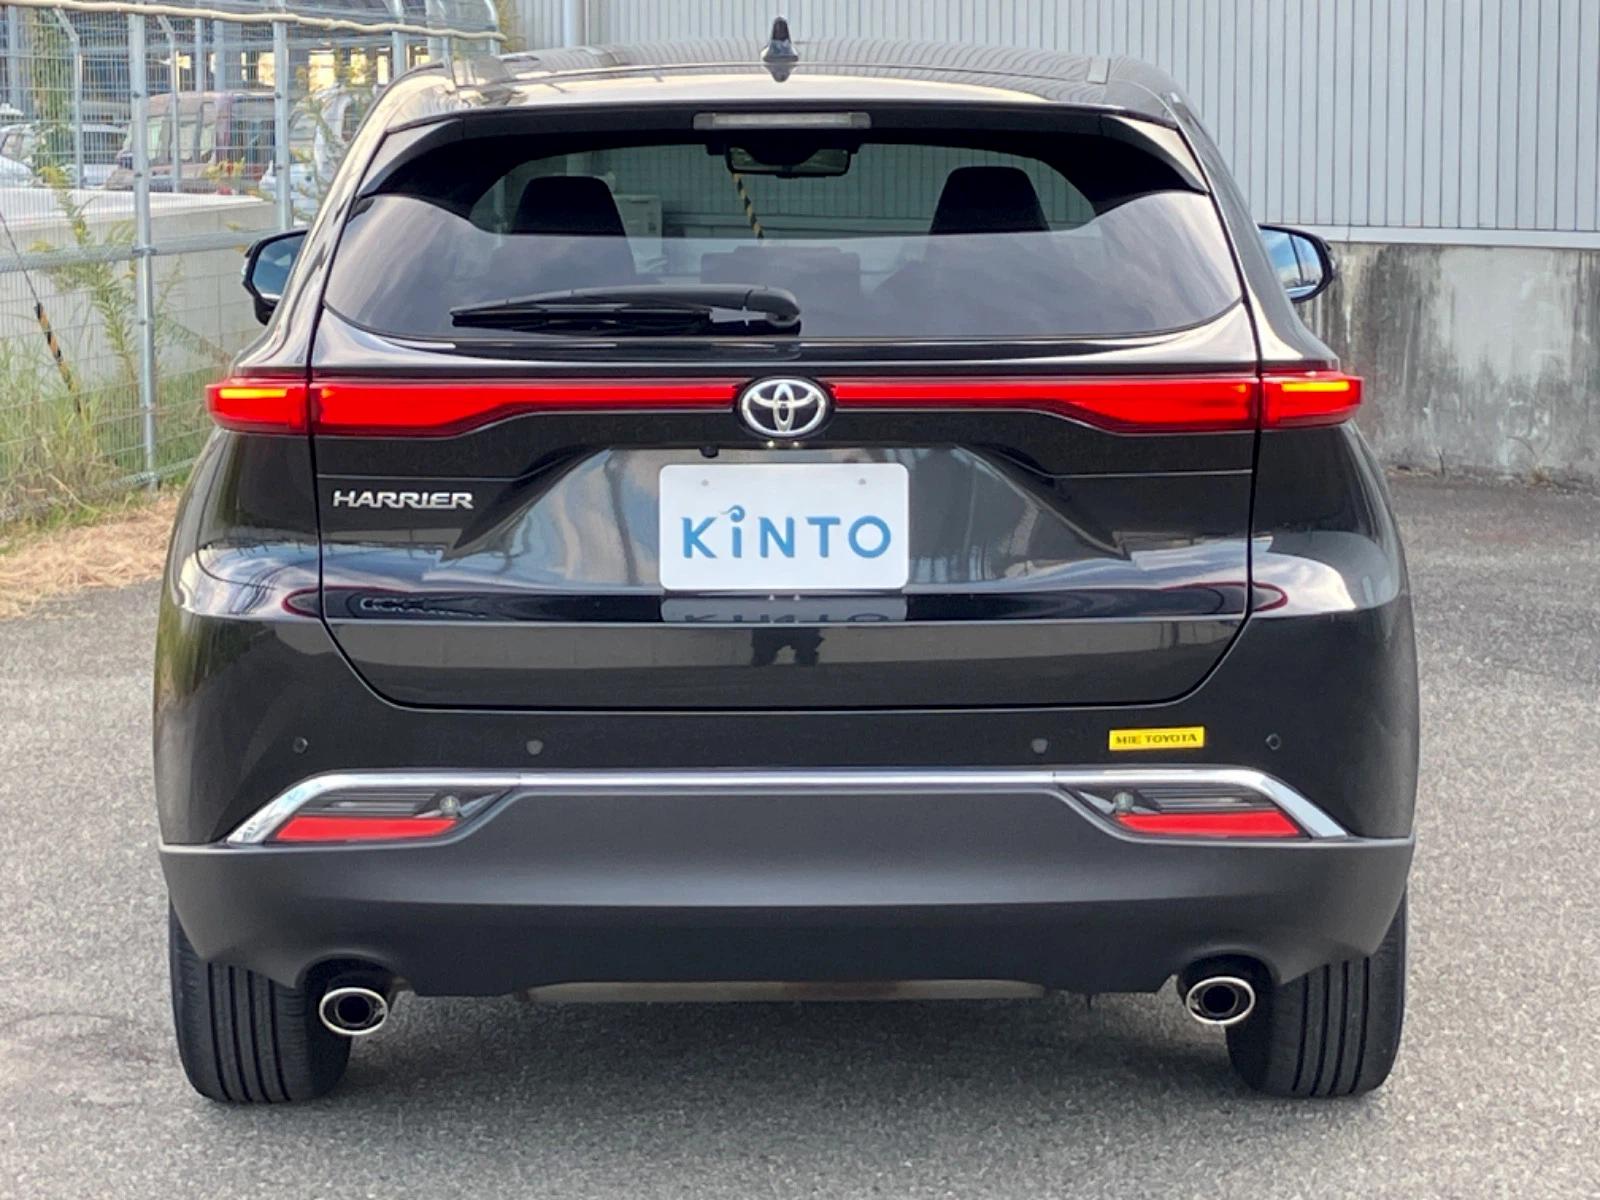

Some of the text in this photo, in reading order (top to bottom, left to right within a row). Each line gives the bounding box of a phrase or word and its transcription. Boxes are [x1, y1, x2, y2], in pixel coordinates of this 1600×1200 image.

[332, 490, 474, 509] HARRIER
[1115, 733, 1198, 745] MIE TOYOTA
